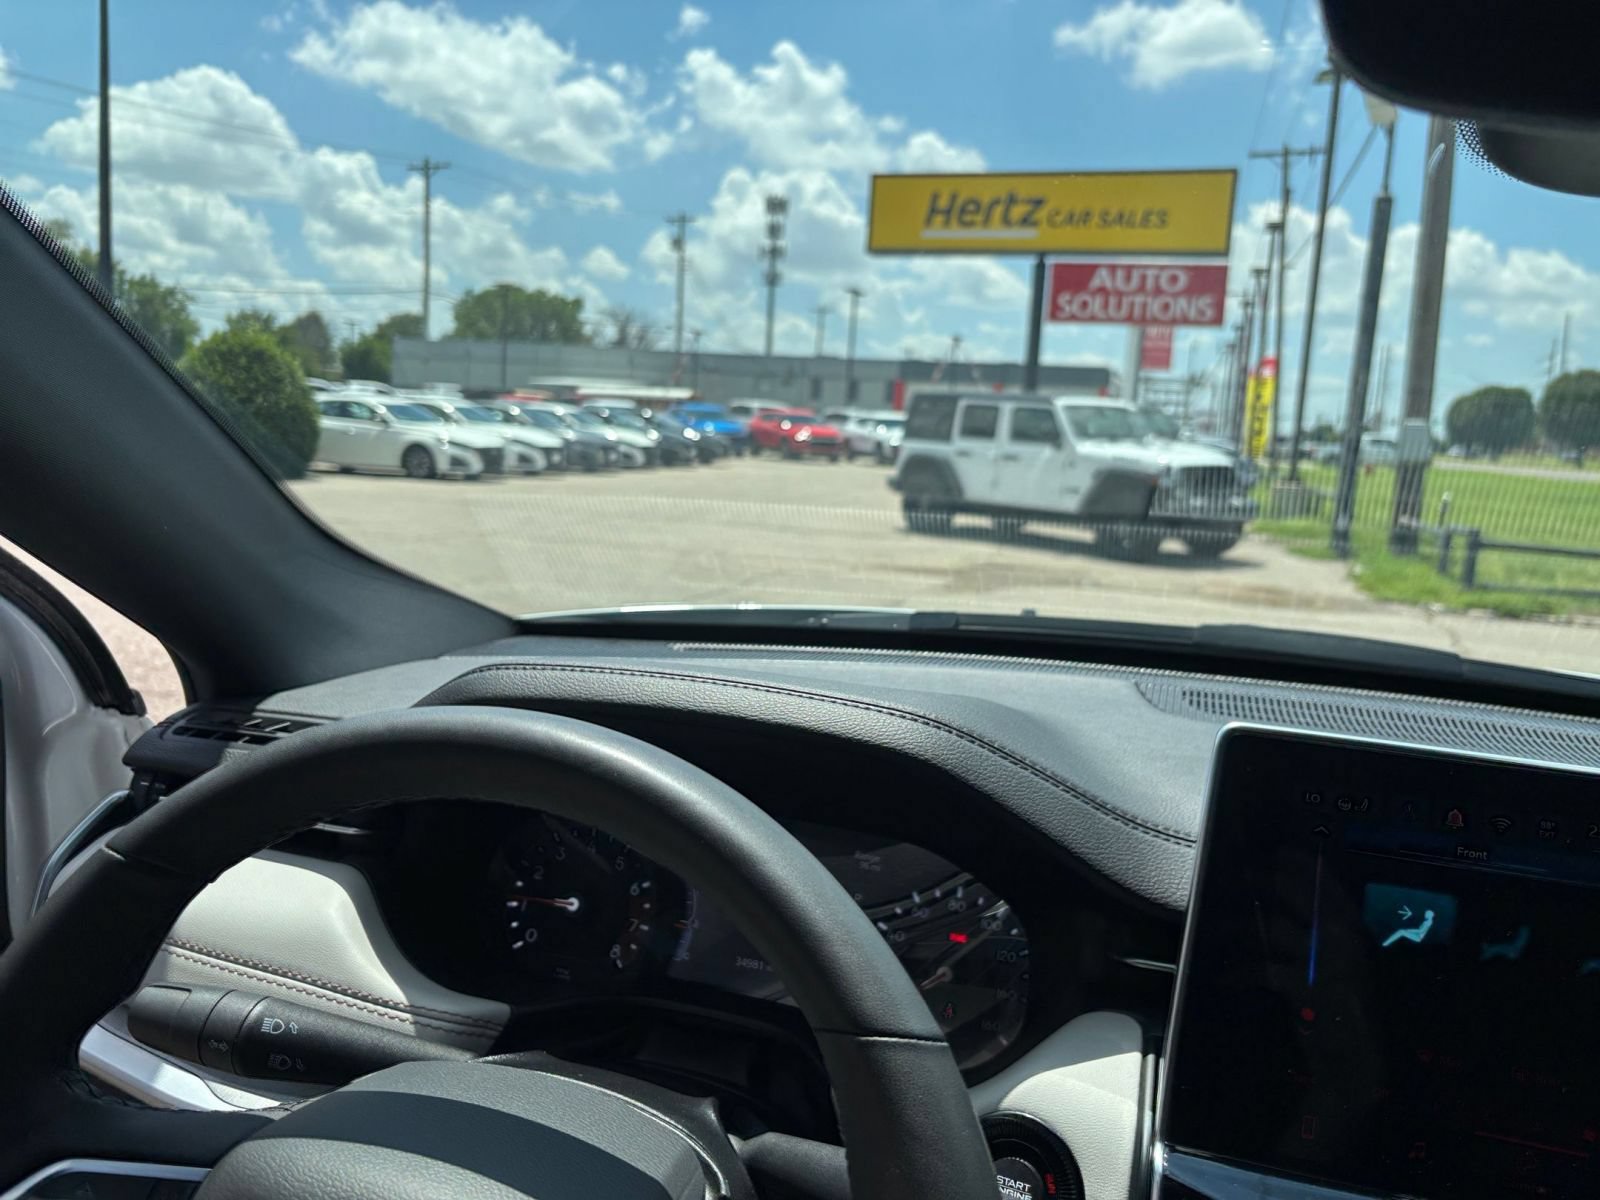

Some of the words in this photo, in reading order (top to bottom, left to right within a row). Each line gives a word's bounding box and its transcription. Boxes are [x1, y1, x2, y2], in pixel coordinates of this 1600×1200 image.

[925, 192, 1046, 228] Hertz
[1048, 208, 1091, 228] CAR
[1098, 208, 1168, 228] SALES
[1091, 267, 1189, 292] AUTO
[1056, 293, 1214, 321] SOLUTIONS
[1457, 846, 1488, 861] Front
[629, 882, 640, 896] 6
[628, 918, 639, 932] 7
[525, 928, 538, 943] 0
[609, 944, 621, 959] 8
[996, 950, 1017, 963] 120
[996, 1175, 1032, 1191] START
[999, 1186, 1033, 1200] NGINE
